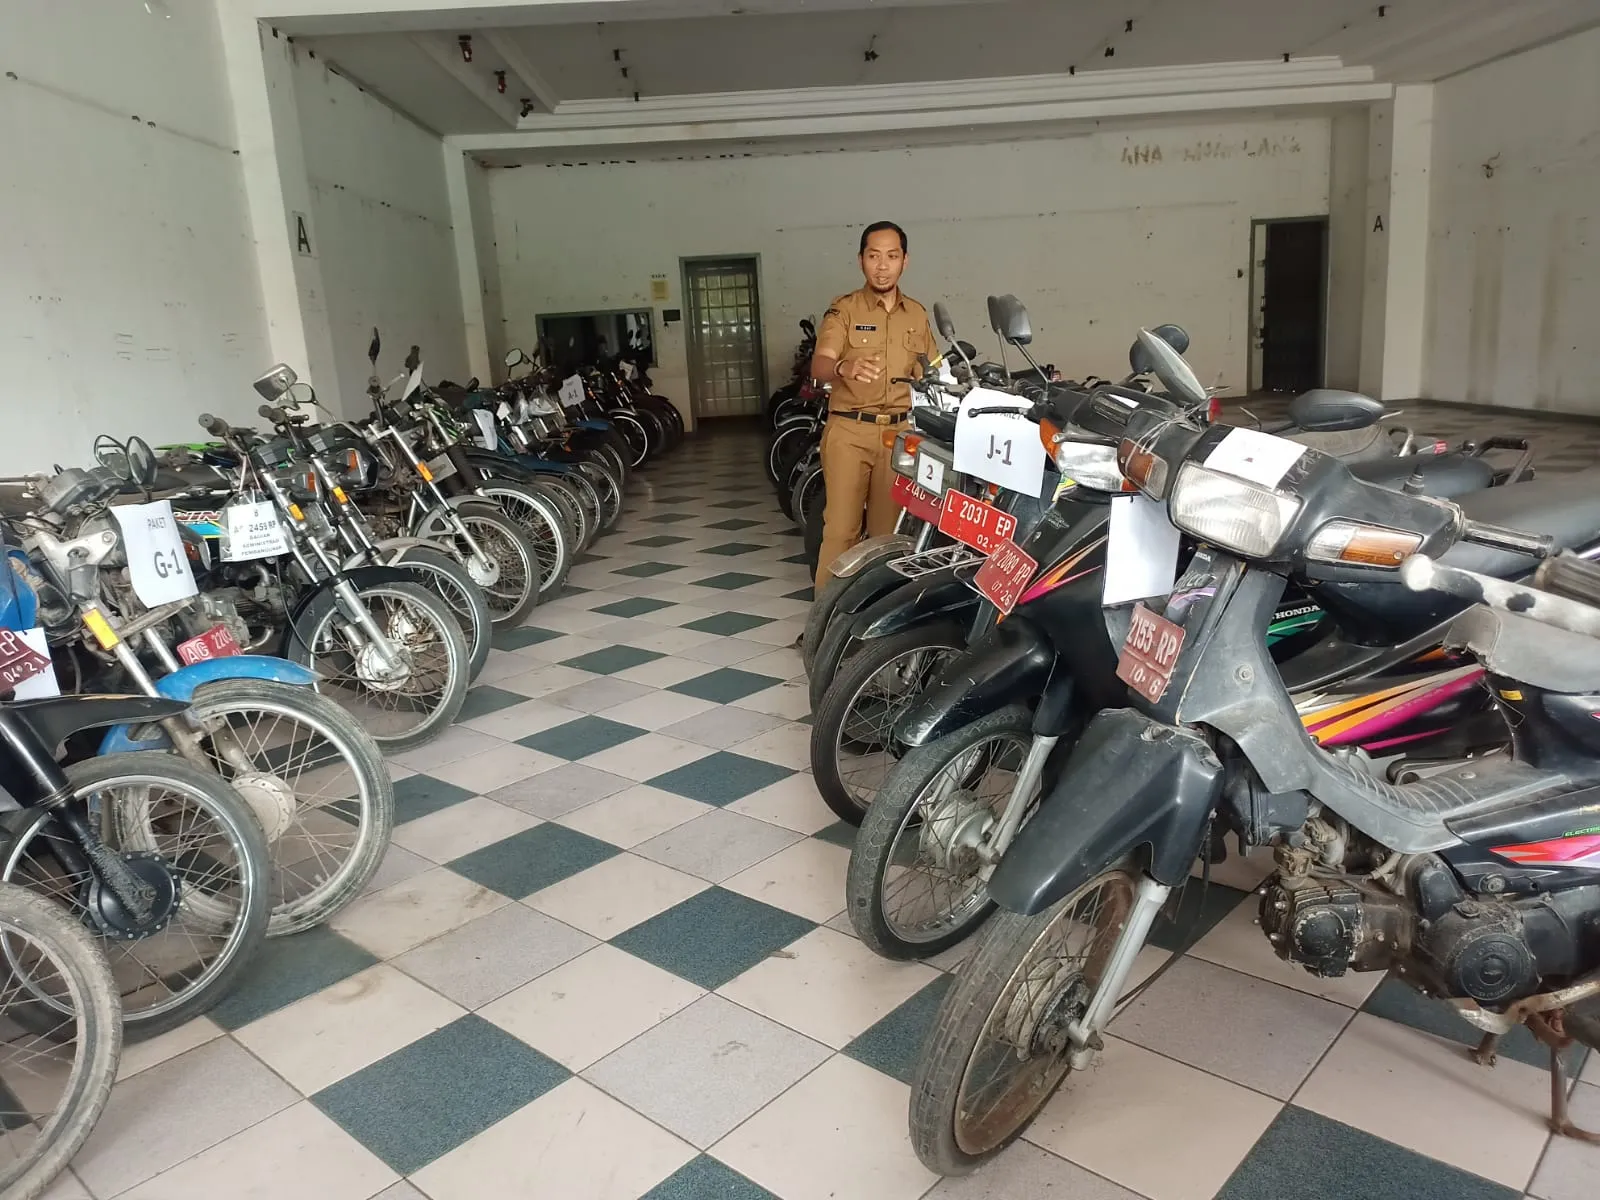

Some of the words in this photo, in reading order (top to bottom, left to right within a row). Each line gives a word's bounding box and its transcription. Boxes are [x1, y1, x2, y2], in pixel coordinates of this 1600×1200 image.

[297, 216, 311, 253] A
[1373, 215, 1384, 232] A
[987, 434, 1012, 465] J-1
[926, 464, 934, 480] 2
[948, 495, 954, 512] L
[960, 501, 988, 527] 2031
[995, 517, 1012, 537] EP
[154, 548, 183, 579] G-1
[997, 550, 1020, 575] 2089
[1012, 563, 1031, 585] RP
[1274, 604, 1321, 620] HONDA
[1126, 614, 1156, 653] 2155
[1154, 631, 1177, 665] RP
